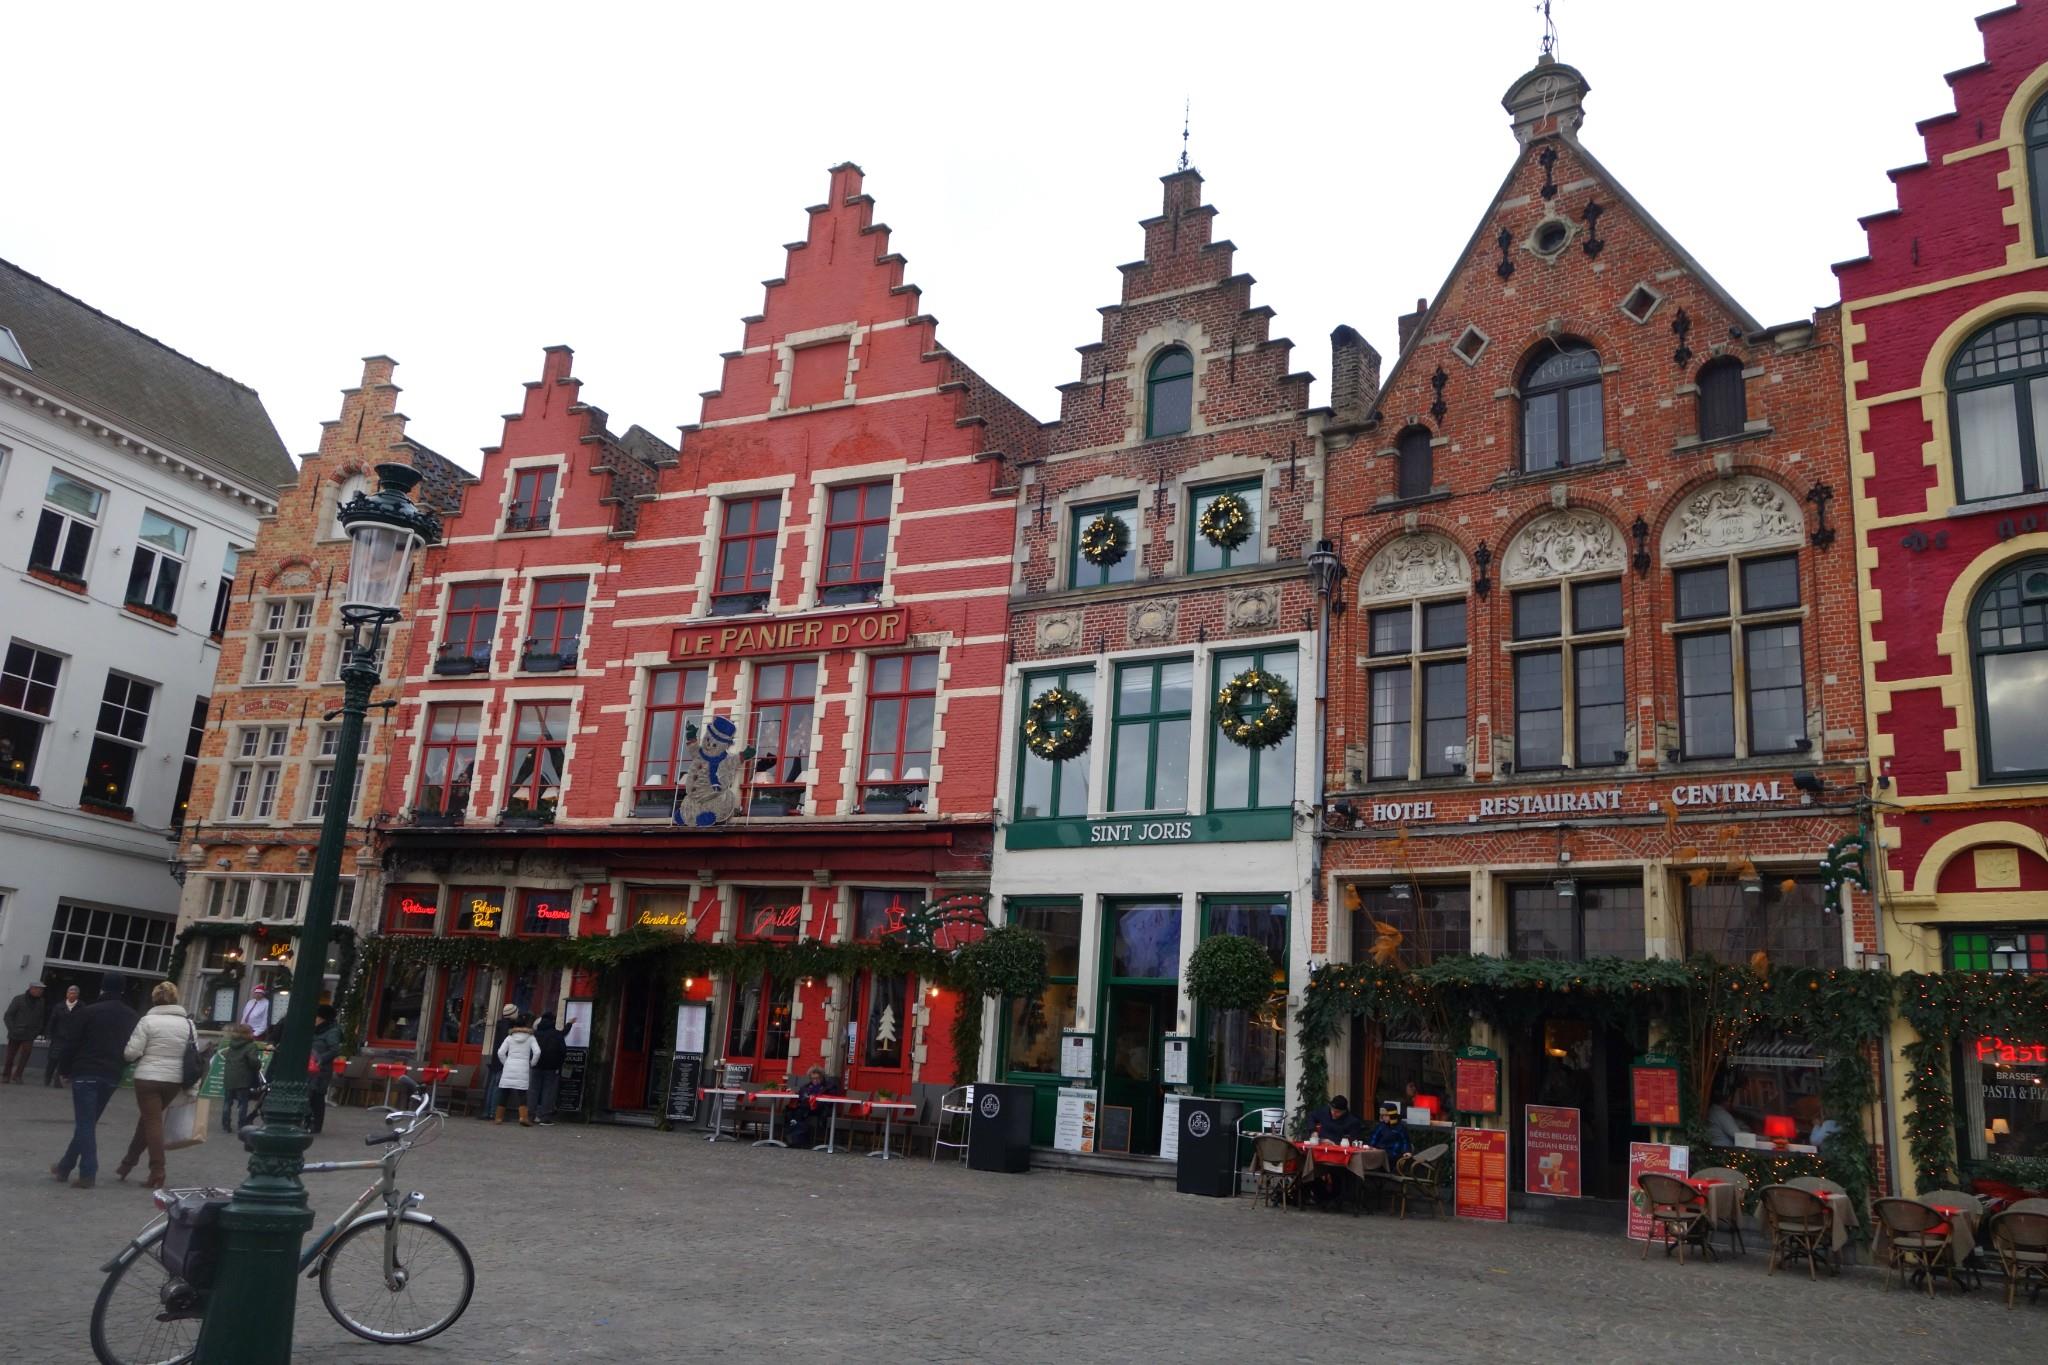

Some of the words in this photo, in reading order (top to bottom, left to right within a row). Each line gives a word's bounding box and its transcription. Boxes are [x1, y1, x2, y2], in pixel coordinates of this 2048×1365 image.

[679, 635, 713, 655] LE
[720, 621, 823, 651] PANIER
[831, 614, 900, 643] D'OR
[1373, 801, 1436, 822] HOTEL
[1479, 790, 1623, 816] RESTAURANT
[1671, 781, 1785, 806] CENTRAL
[1091, 824, 1133, 842] SINT
[1138, 821, 1192, 840] JORIS
[471, 899, 502, 920] Belgian
[754, 903, 801, 936] Grill
[472, 913, 495, 928] Beers
[1981, 1085, 2017, 1099] PASTA
[2018, 1086, 2028, 1100] &
[1527, 1140, 1558, 1149] BELGIAN
